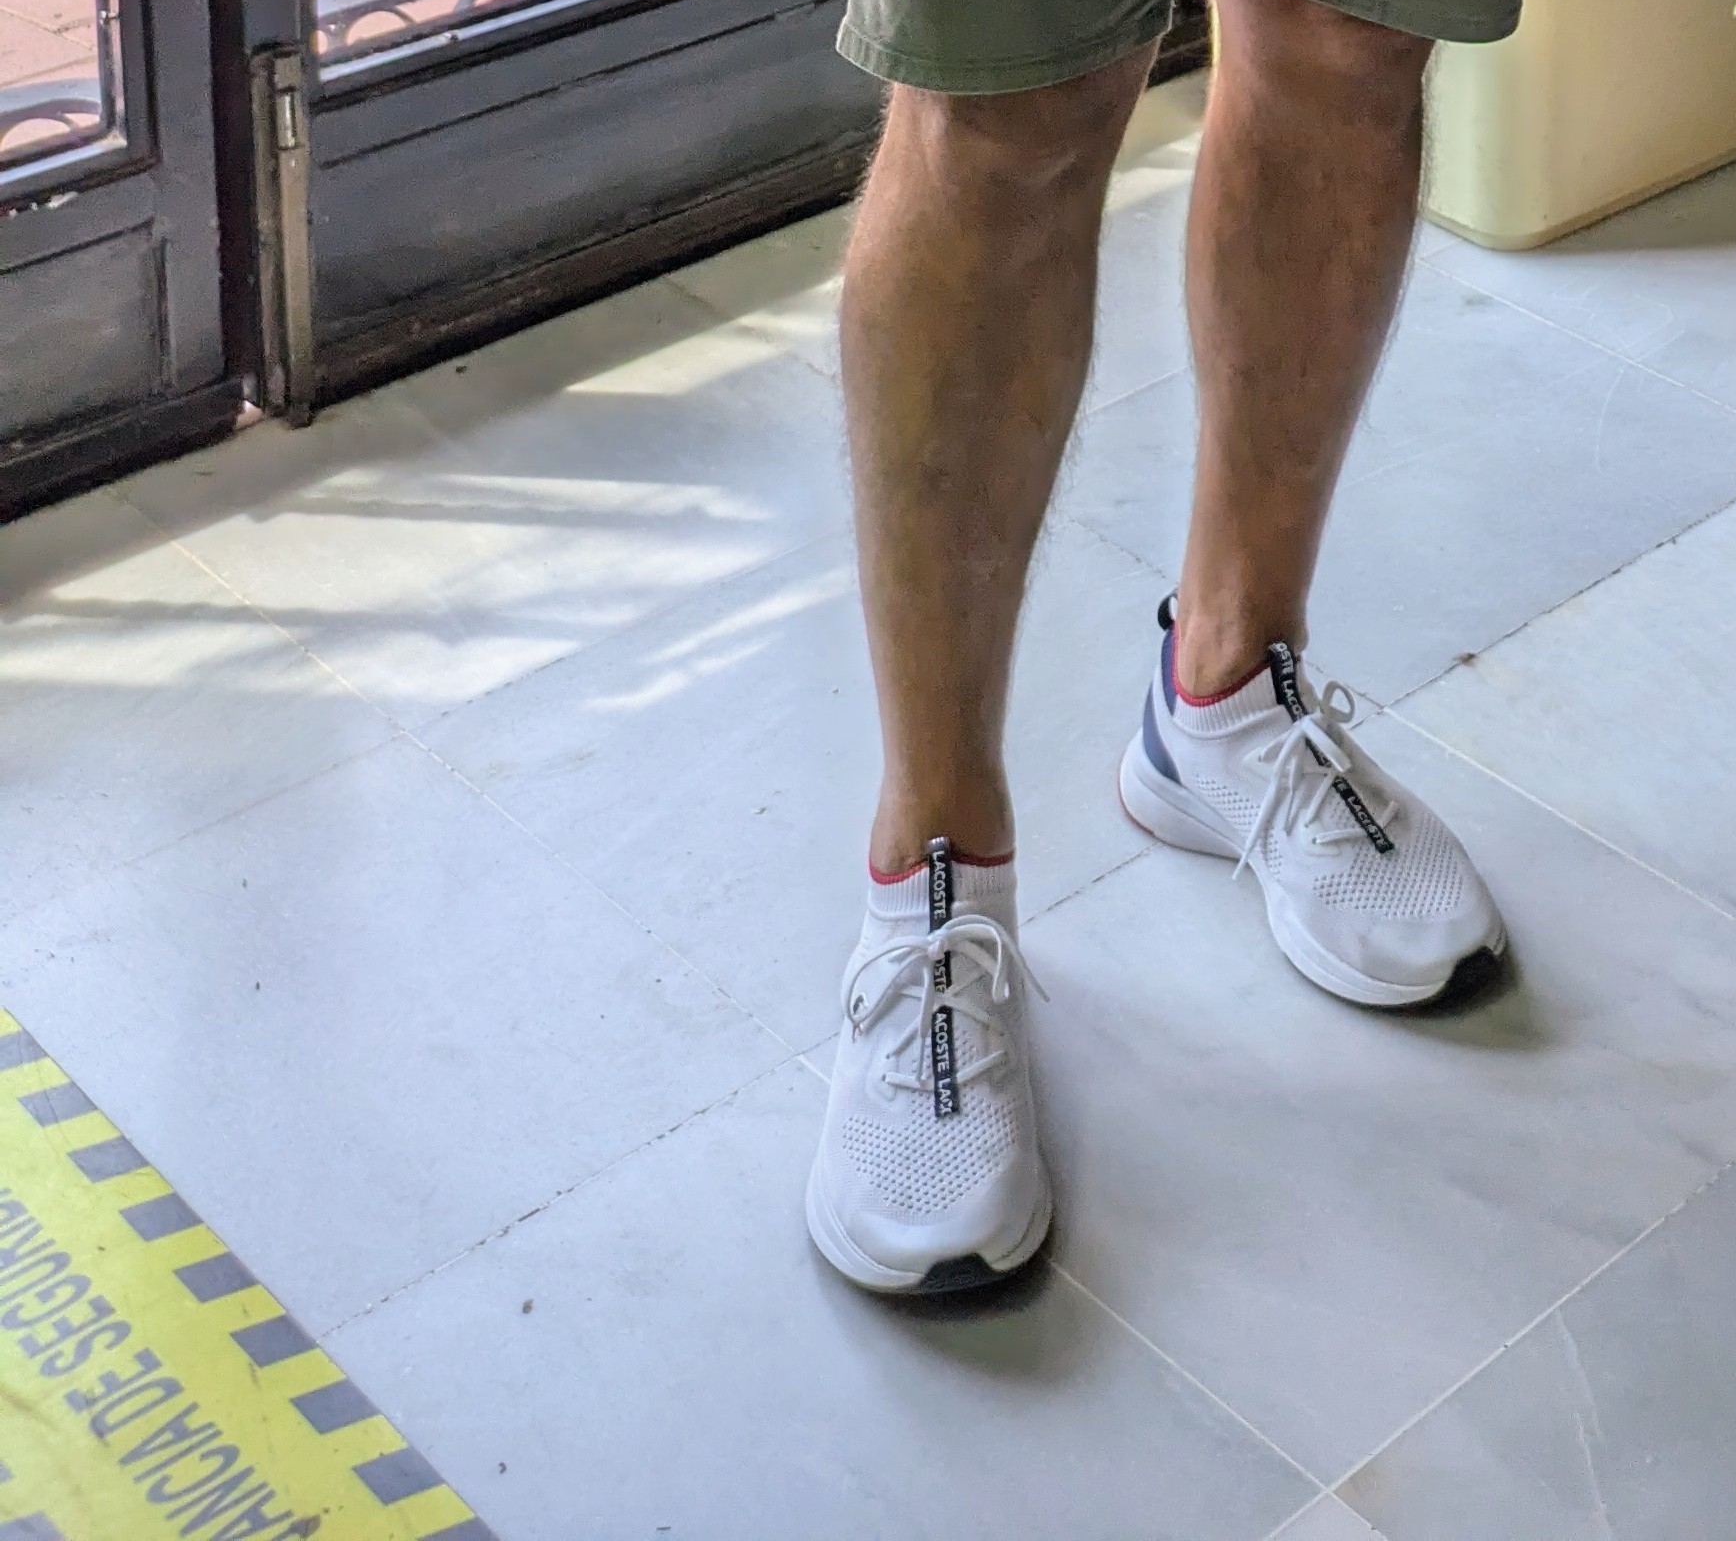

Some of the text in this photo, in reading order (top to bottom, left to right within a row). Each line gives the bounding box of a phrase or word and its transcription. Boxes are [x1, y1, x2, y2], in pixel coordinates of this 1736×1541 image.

[932, 850, 946, 919] LACOSTE
[936, 1012, 950, 1073] ACOSTE
[63, 1346, 185, 1441] DE
